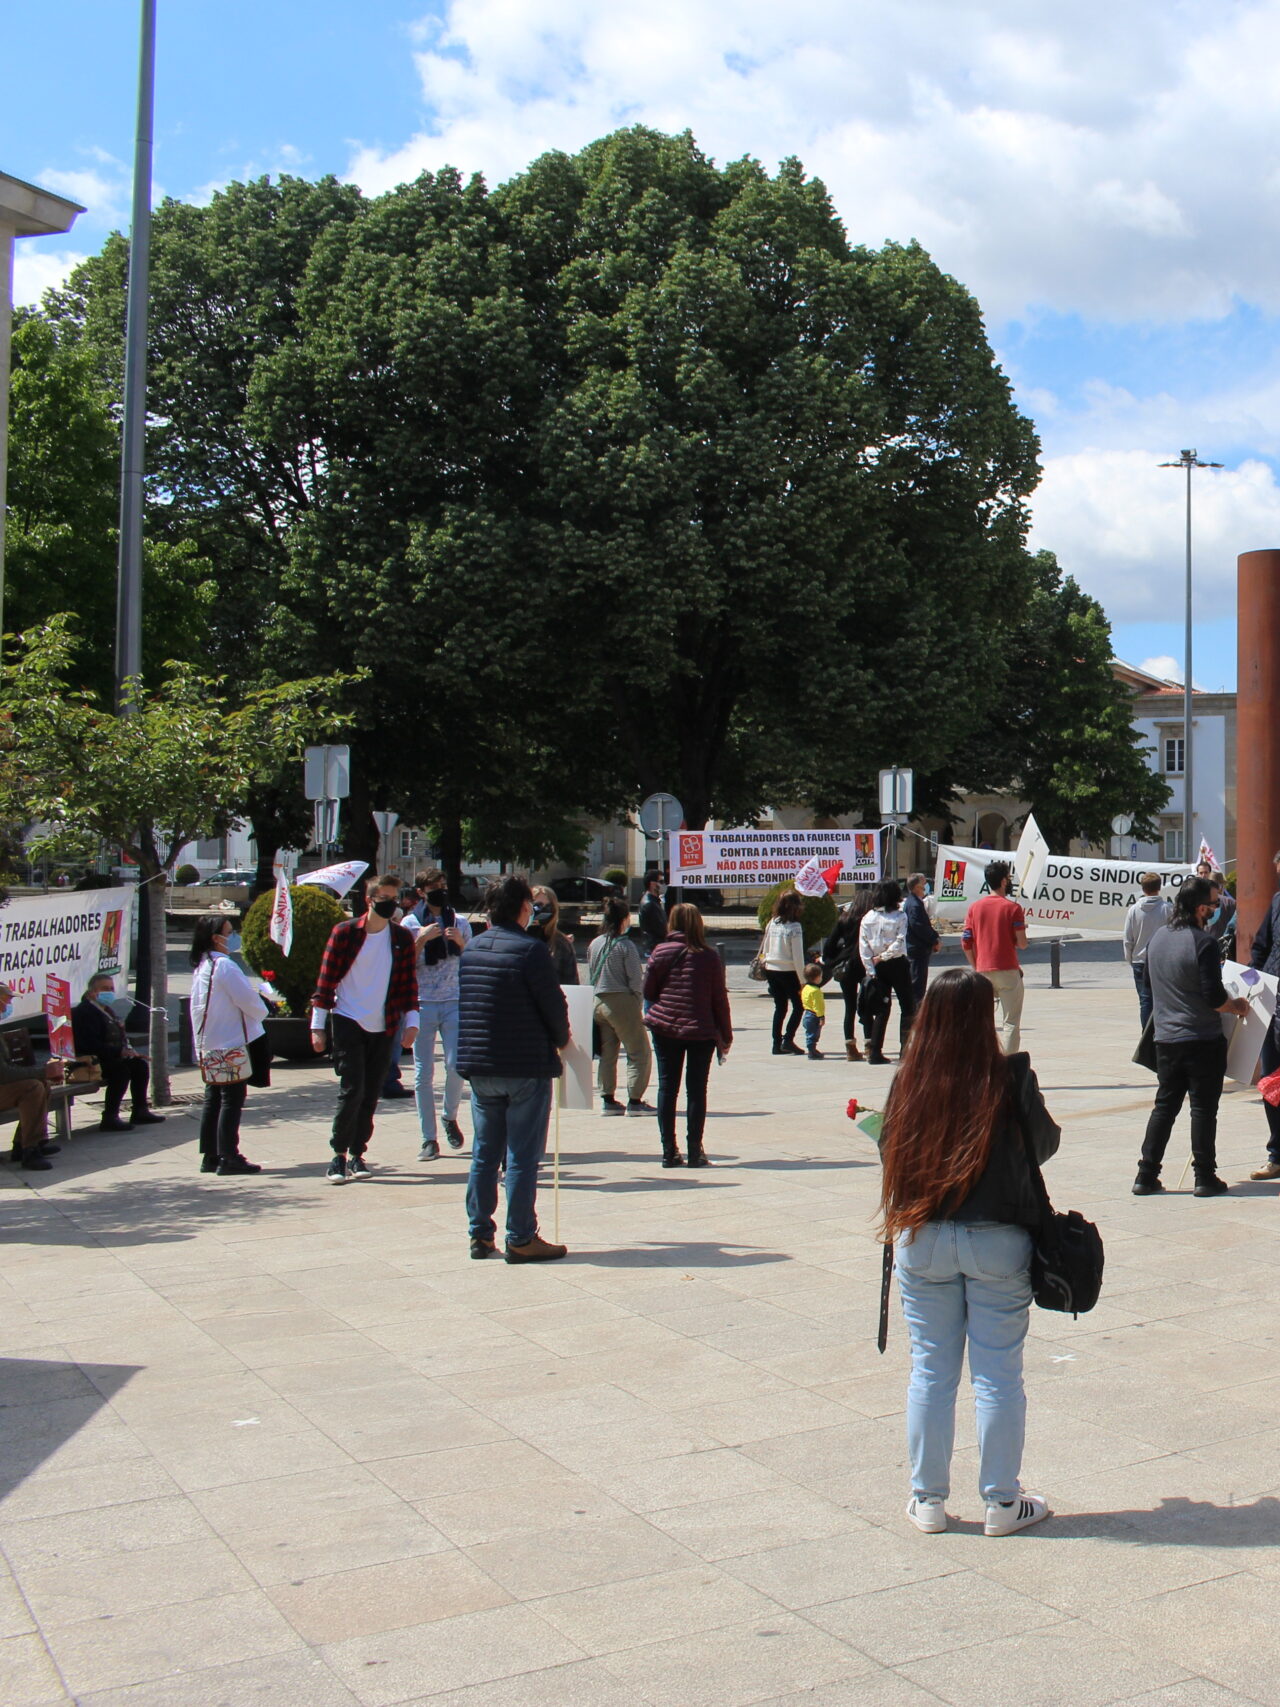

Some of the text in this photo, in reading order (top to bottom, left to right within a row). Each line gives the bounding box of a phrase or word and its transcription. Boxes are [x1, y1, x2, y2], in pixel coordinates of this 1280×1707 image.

[709, 833, 851, 843] TRABALHADORES DA FAURECIA
[720, 846, 840, 858] CONTRA A PRECARIEDADE
[717, 858, 737, 870] NÃO
[739, 860, 759, 870] AOS
[761, 860, 797, 870] BAIXOS
[681, 875, 702, 885] POR
[704, 873, 756, 884] MELHORES
[1046, 864, 1084, 880] DOS
[1071, 888, 1094, 905] DE
[5, 912, 102, 943] TRABALHADORES
[46, 942, 82, 965] LOCAL
